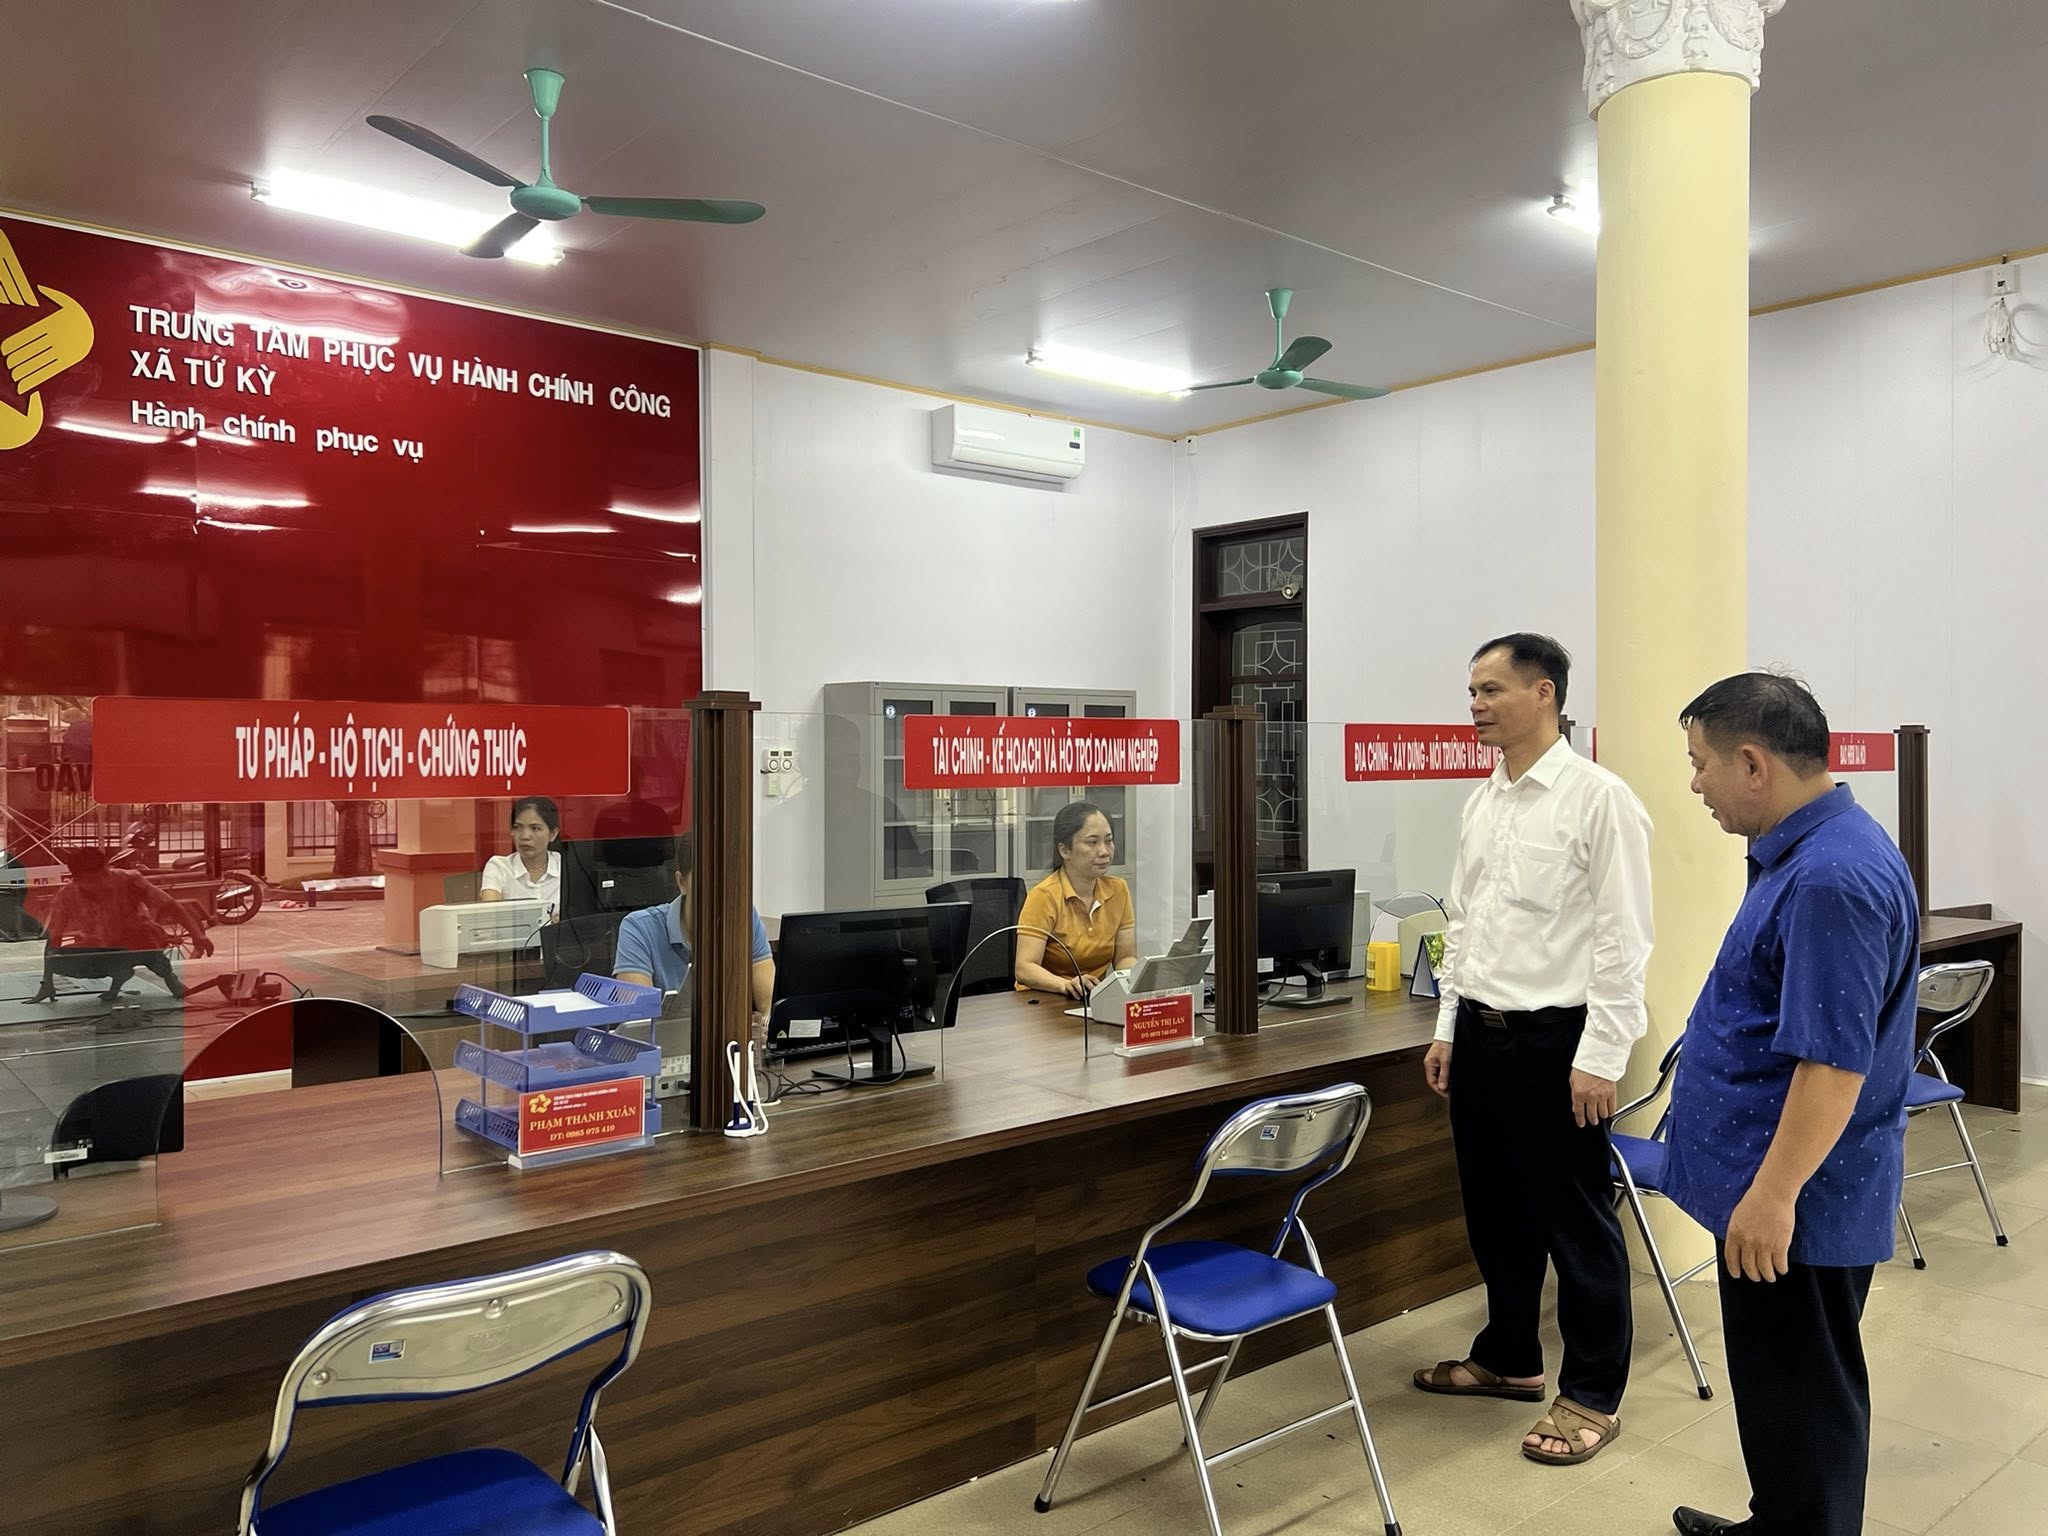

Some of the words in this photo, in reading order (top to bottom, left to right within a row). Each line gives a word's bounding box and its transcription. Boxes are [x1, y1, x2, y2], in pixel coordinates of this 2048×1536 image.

[129, 304, 234, 347] TRUNG
[323, 338, 396, 375] PHỤC
[408, 352, 443, 385] VỤ
[452, 356, 518, 393] HÀNH
[528, 373, 594, 405] CHÍNH
[609, 384, 671, 418] CÔNG
[130, 347, 176, 382] XÃ
[184, 355, 226, 388] TỨ
[236, 364, 277, 396] KỲ
[131, 400, 205, 431] Hành
[223, 414, 295, 443] chính
[316, 426, 378, 457] phục
[393, 439, 423, 463] vụ
[236, 718, 260, 779] TƯ
[264, 711, 315, 779] PHÁP
[319, 752, 326, 764] -
[330, 713, 358, 792] HỘ
[362, 728, 403, 792] TỊCH
[408, 752, 414, 763] -
[418, 713, 480, 777] CHỨNG
[484, 722, 527, 790] THỰC
[933, 726, 948, 775] TÀI
[951, 726, 984, 775] CHÍNH
[992, 721, 1005, 774] KẾ
[1006, 737, 1041, 784] HOẠCH
[1044, 727, 1057, 773] VÀ
[1075, 733, 1092, 783] TRỢ
[1094, 737, 1126, 773] DOANH
[1127, 728, 1158, 782] NGHIỆP
[1354, 741, 1367, 780] ĐỊA
[1367, 733, 1389, 772] CHÍNH
[1393, 733, 1406, 771] XÂY
[1407, 737, 1425, 779] DỰNG
[1442, 733, 1466, 770] TRƯỜNG
[529, 1117, 563, 1132] PHẠM
[565, 1111, 604, 1126] THANH
[606, 1105, 637, 1120] XUÂN
